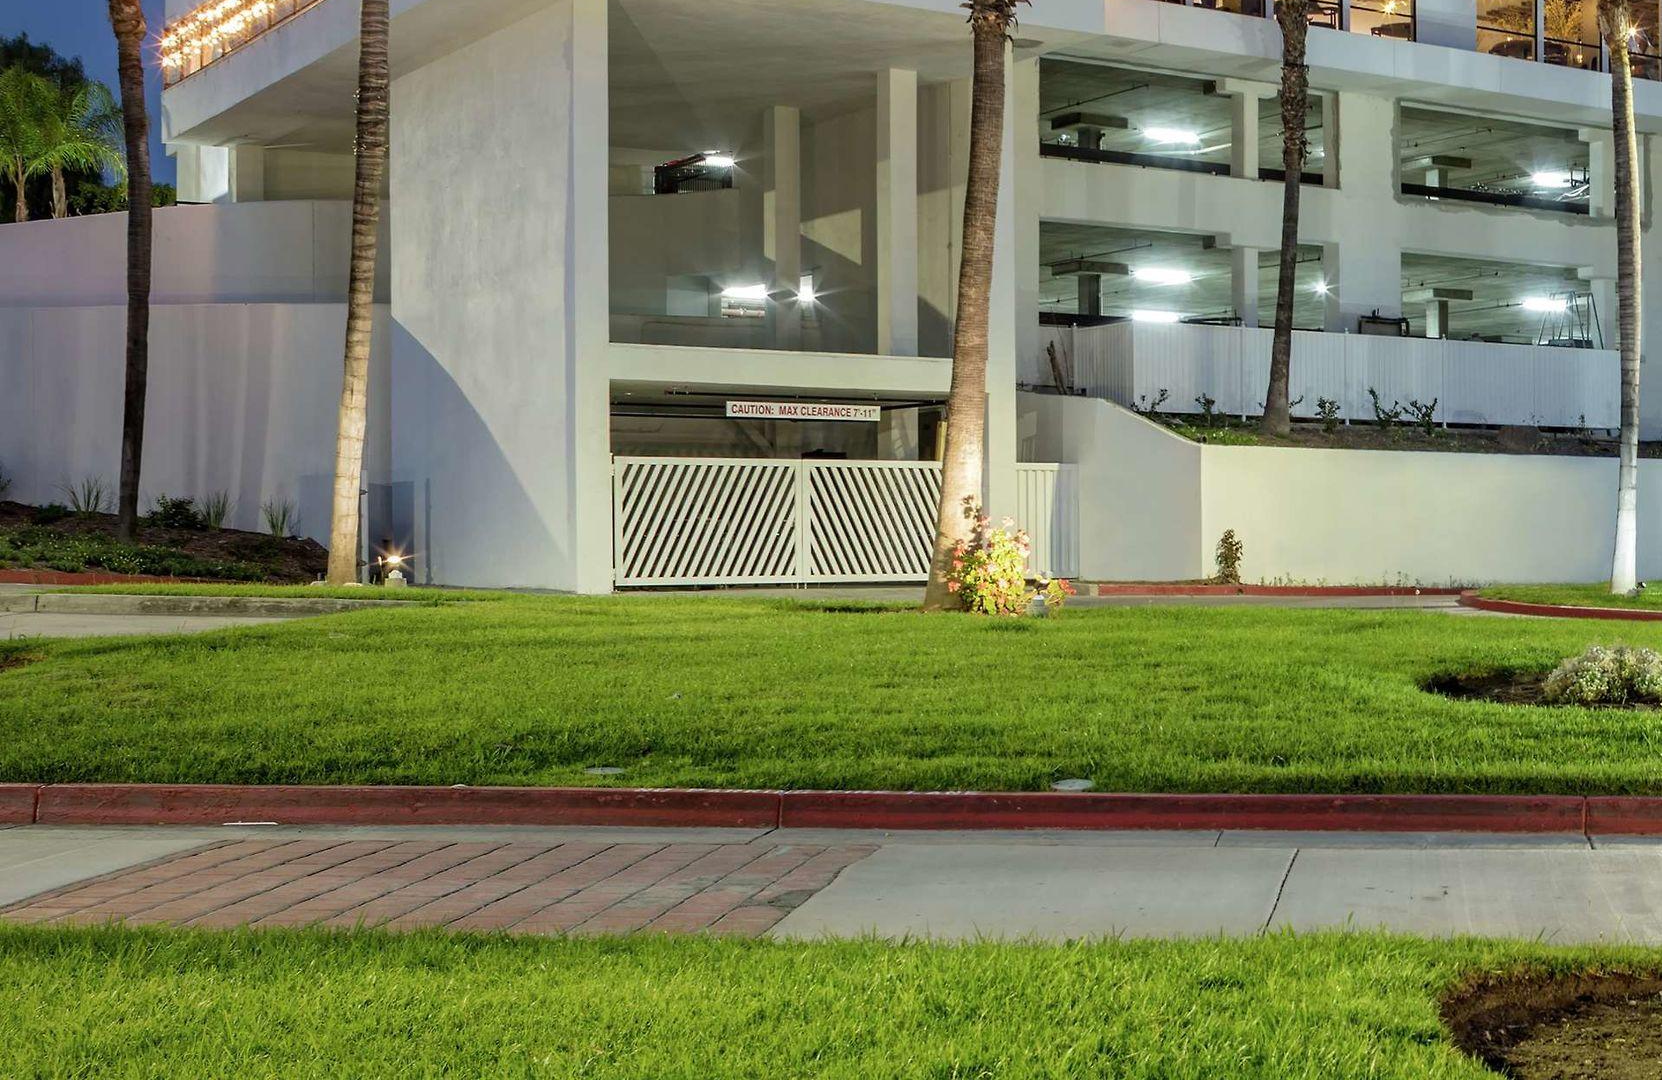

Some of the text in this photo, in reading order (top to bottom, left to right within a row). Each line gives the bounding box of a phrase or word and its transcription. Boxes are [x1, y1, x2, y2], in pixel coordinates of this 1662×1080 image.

[731, 403, 774, 415] CAUTION:
[778, 405, 799, 416] MAX
[800, 406, 851, 417] CLEARANCE
